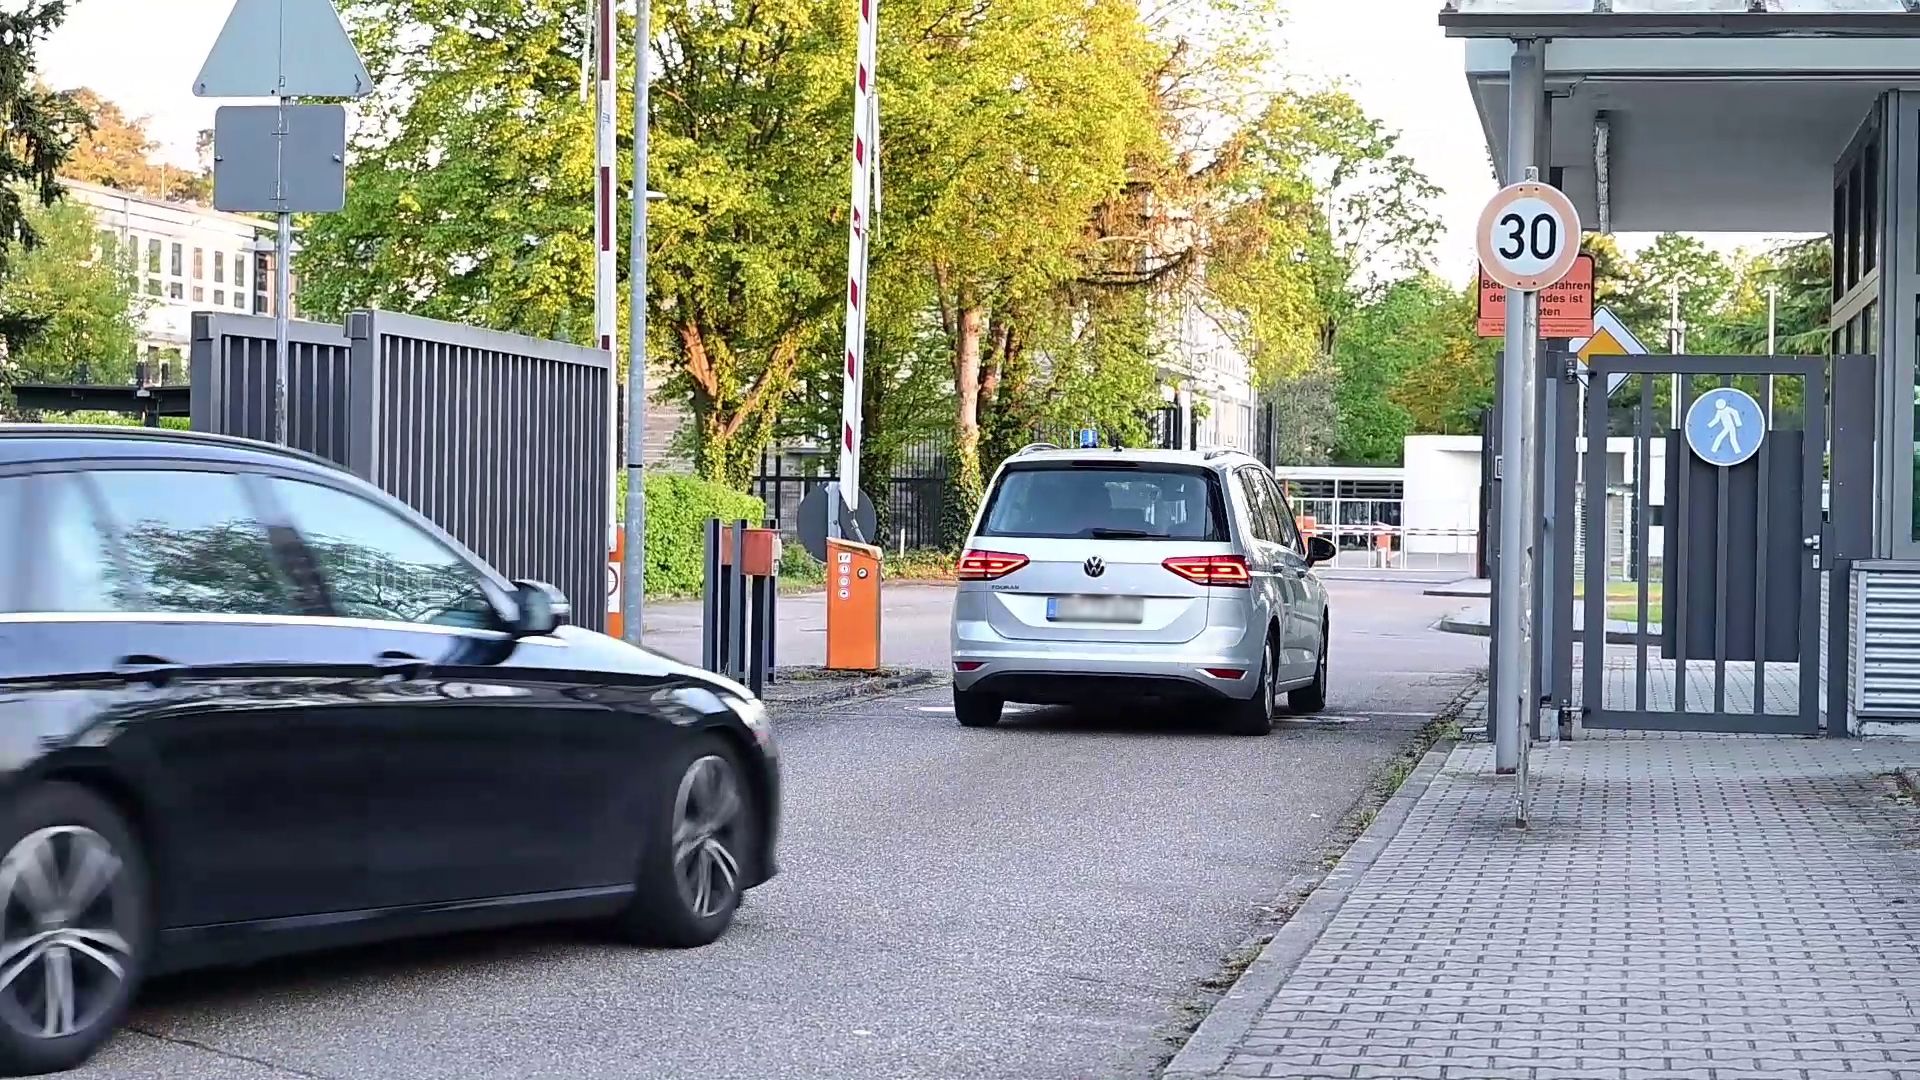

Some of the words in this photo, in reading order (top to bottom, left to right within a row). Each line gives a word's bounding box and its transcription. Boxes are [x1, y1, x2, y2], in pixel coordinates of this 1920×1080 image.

[1498, 213, 1557, 260] 30
[1547, 280, 1591, 290] efahren
[1539, 293, 1565, 303] ndes
[1569, 293, 1584, 303] ist
[1538, 307, 1560, 316] oten
